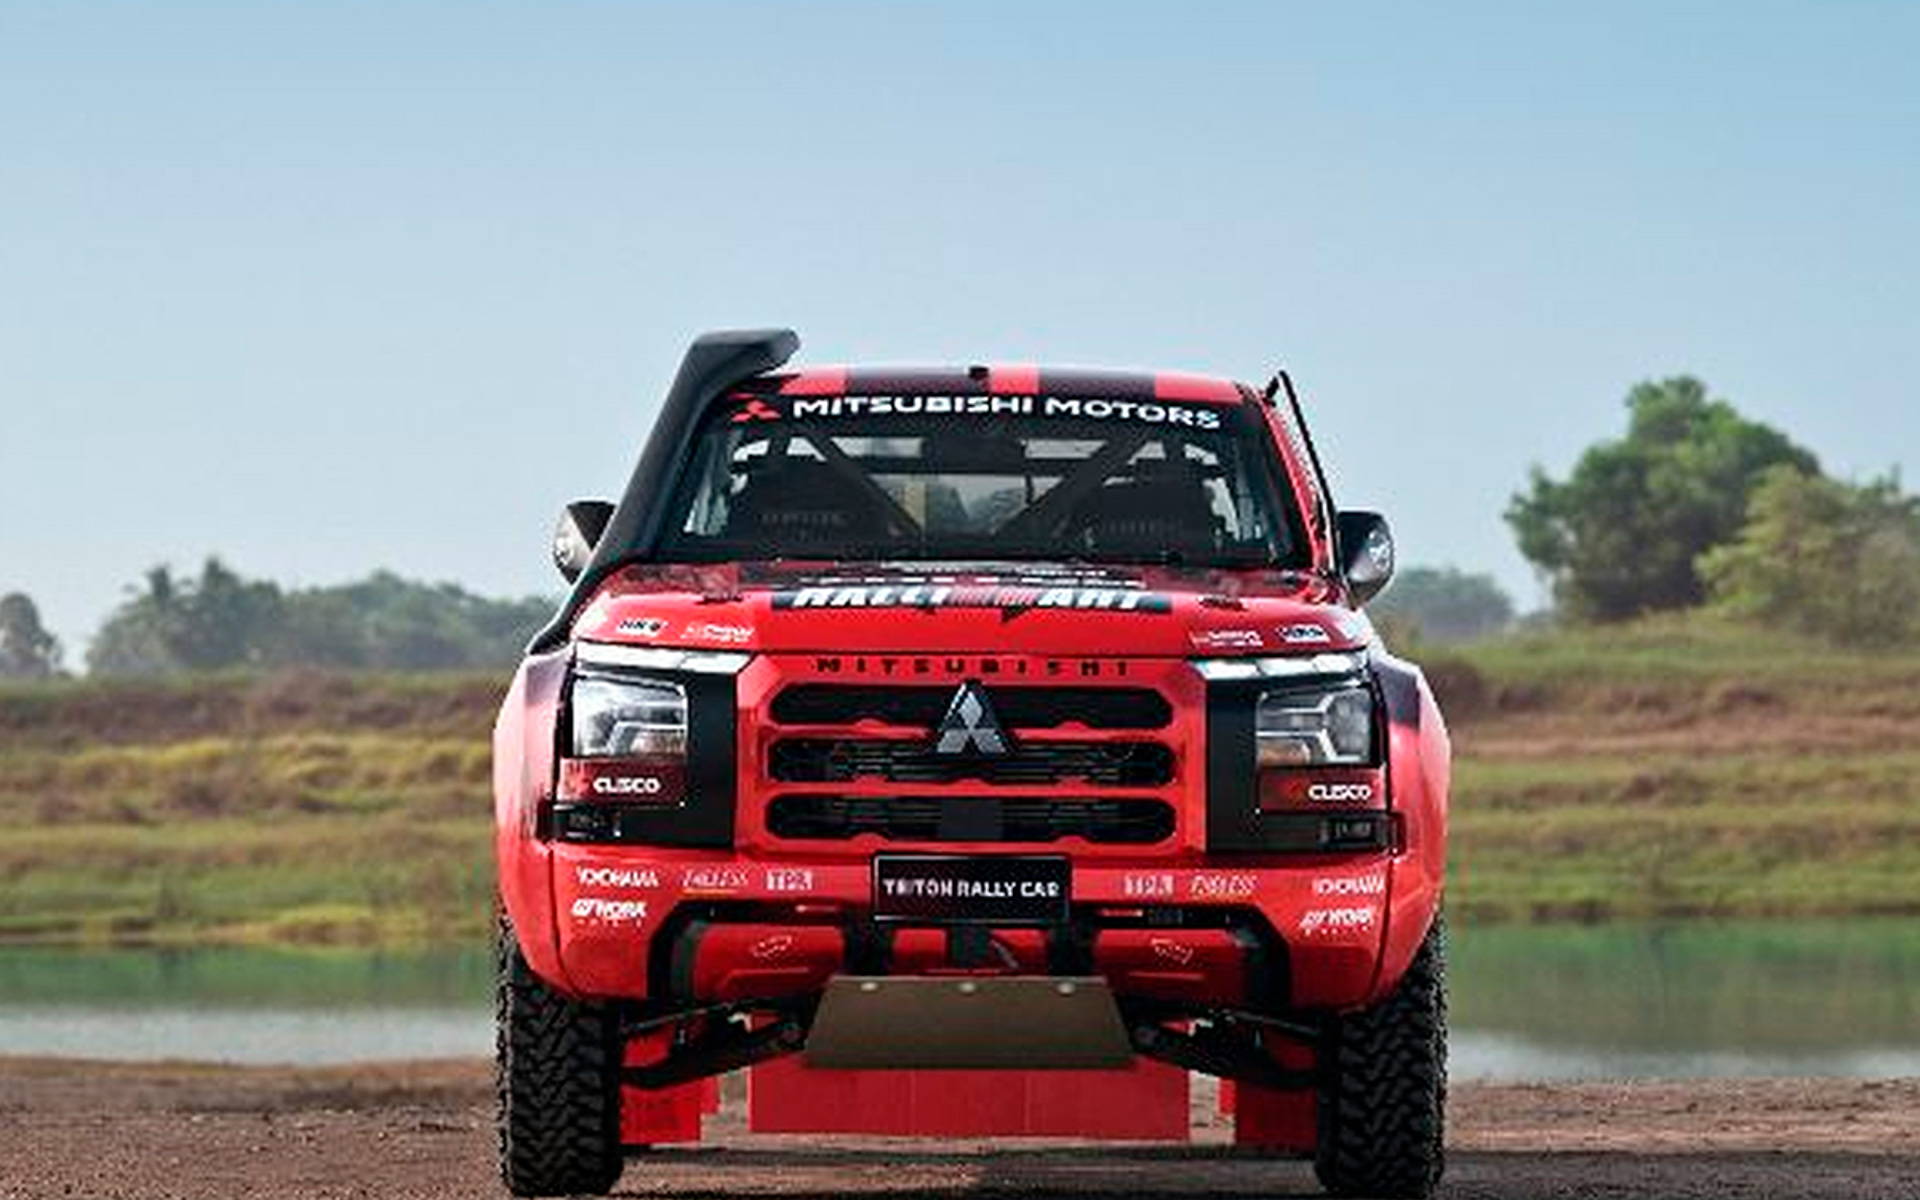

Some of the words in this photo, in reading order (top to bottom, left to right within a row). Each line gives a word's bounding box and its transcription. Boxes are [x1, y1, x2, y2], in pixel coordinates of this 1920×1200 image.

[793, 396, 1032, 418] MITSUBISHI
[1045, 398, 1221, 430] MOTORS
[816, 658, 1128, 676] MITSUBISHI
[957, 878, 1017, 898] RALLY
[1020, 880, 1061, 898] CAR
